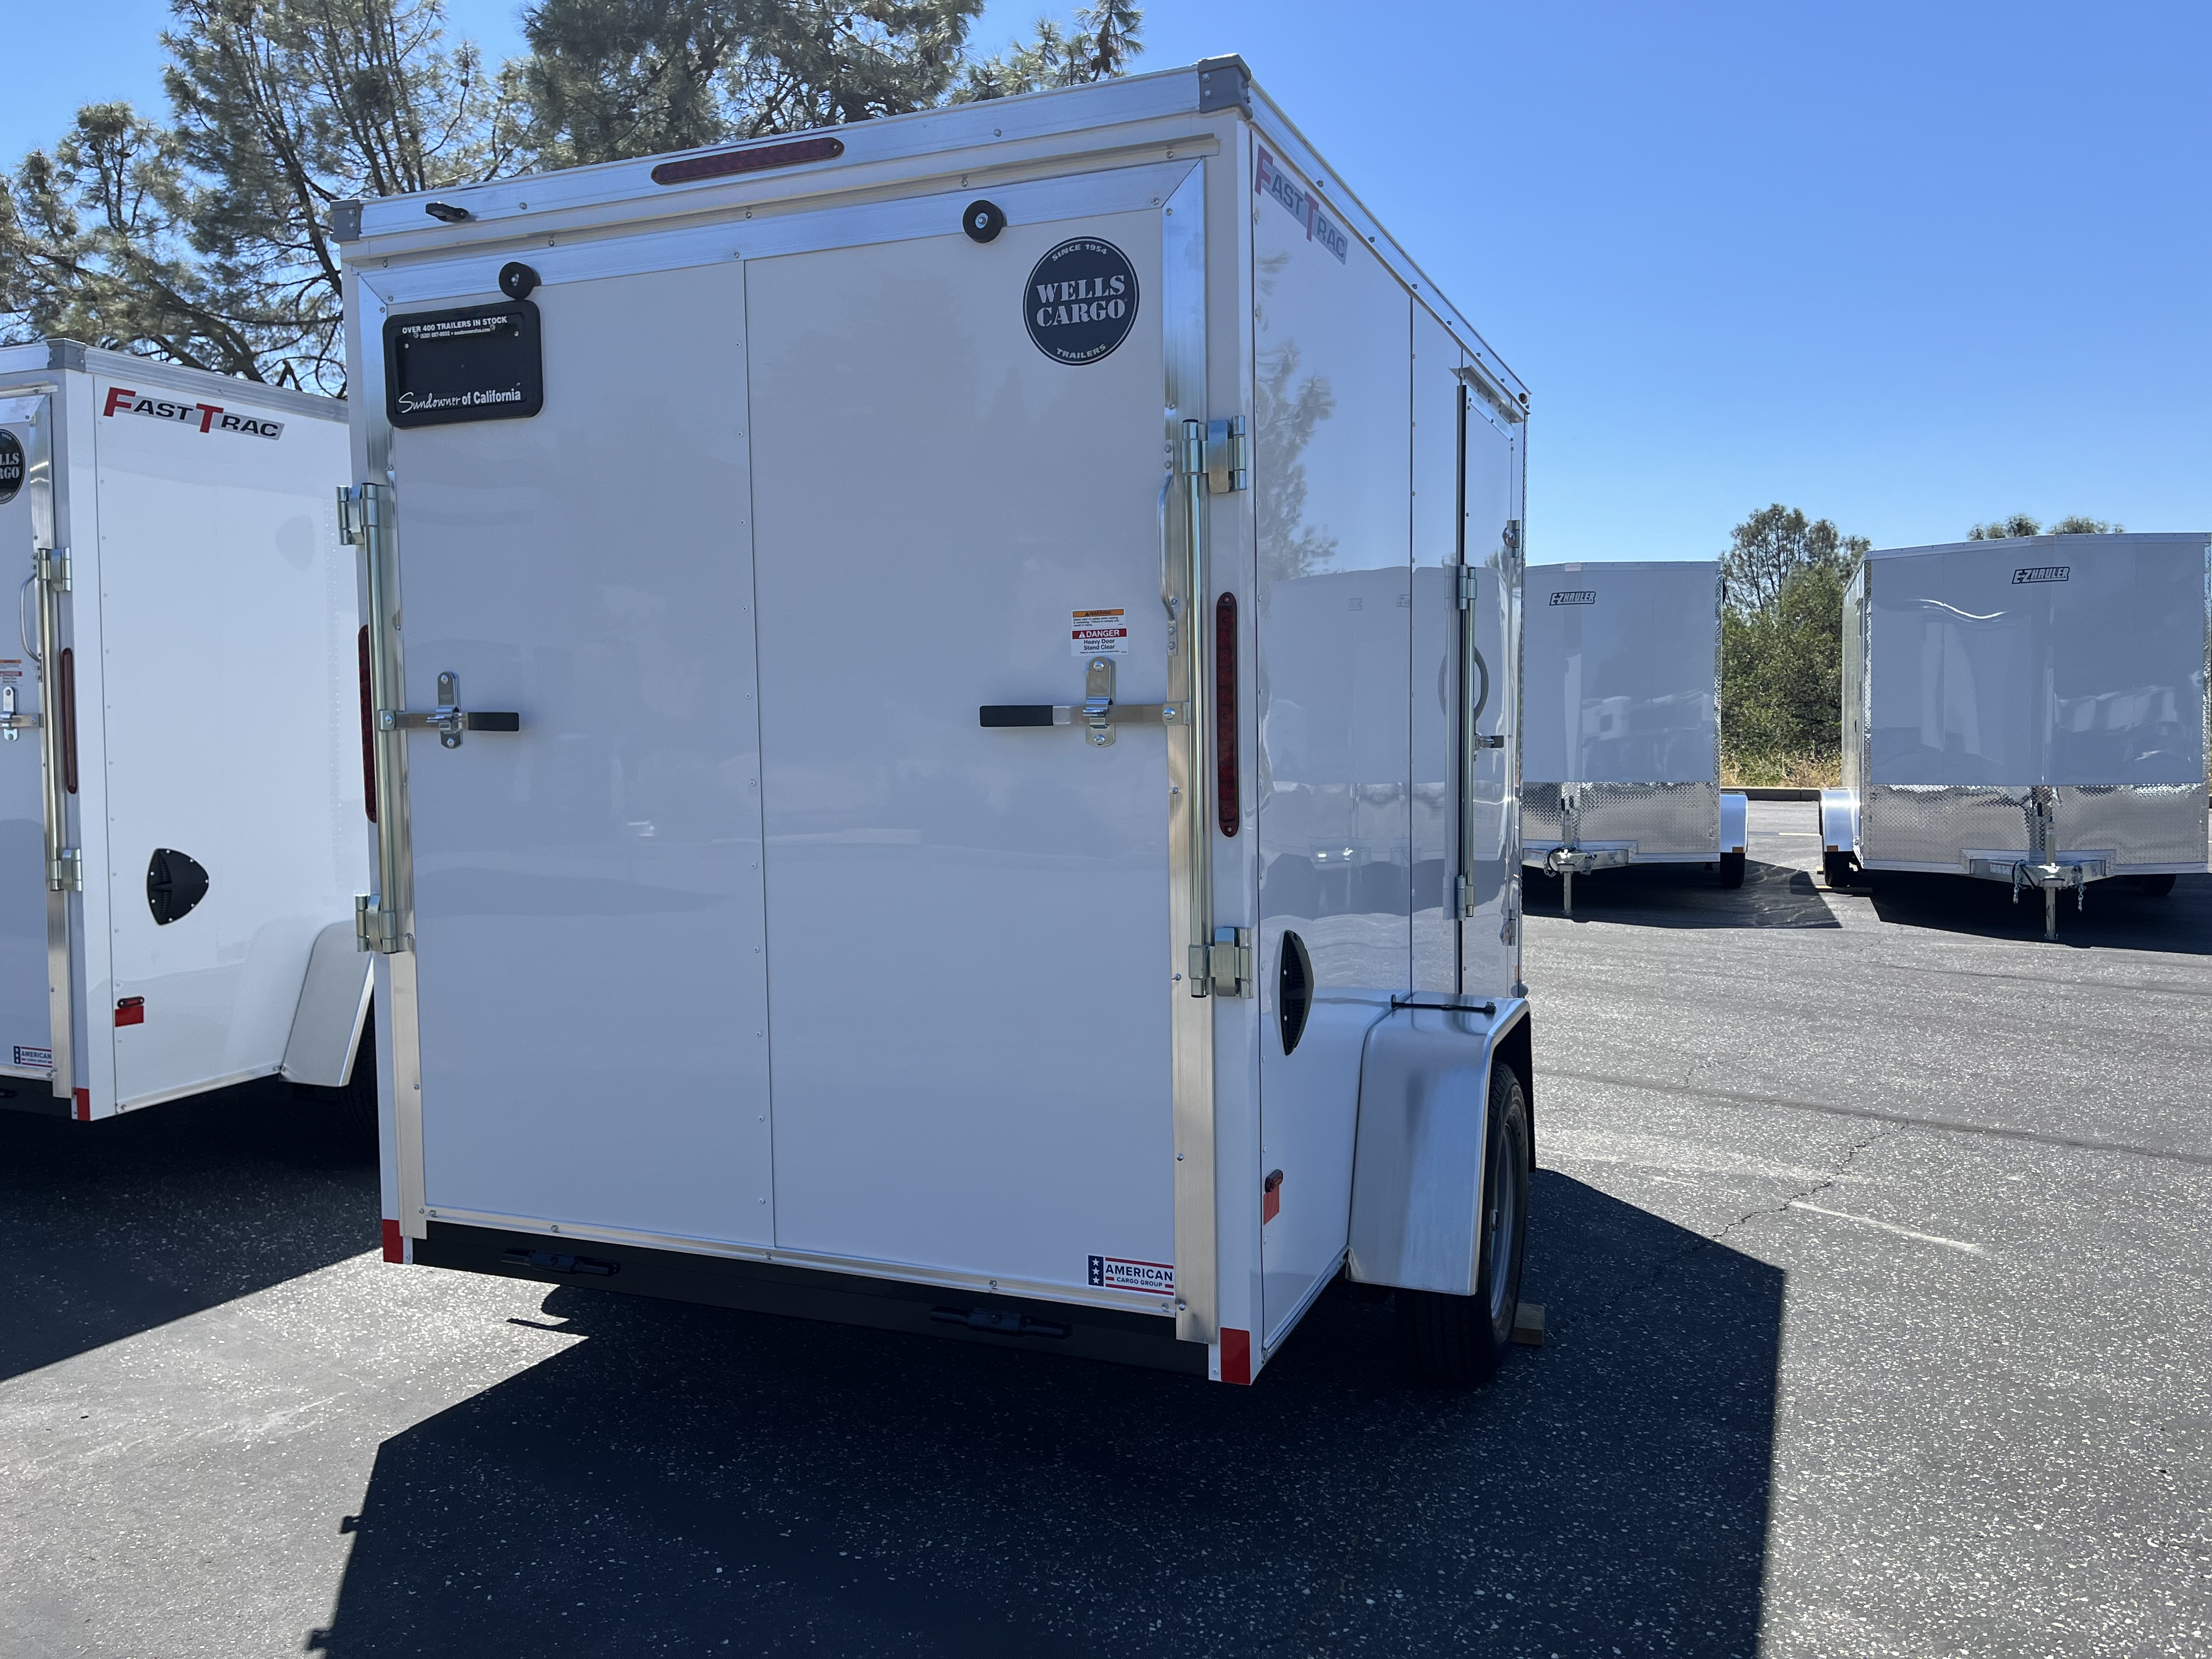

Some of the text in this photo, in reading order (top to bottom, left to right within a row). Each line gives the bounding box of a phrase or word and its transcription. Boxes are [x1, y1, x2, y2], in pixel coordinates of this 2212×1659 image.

[1052, 244, 1108, 262] SINCE 1954
[1036, 275, 1125, 303] WELLS
[1036, 299, 1125, 327] CARGO
[437, 320, 471, 330] TRAILERS
[482, 316, 507, 325] STOCK
[1056, 344, 1106, 359] TRAILERS
[399, 388, 521, 413] Sundowner of California
[1086, 629, 1120, 637] DANGER
[21, 1051, 52, 1059] AMERICAN
[1105, 1265, 1173, 1282] AMERICAN
